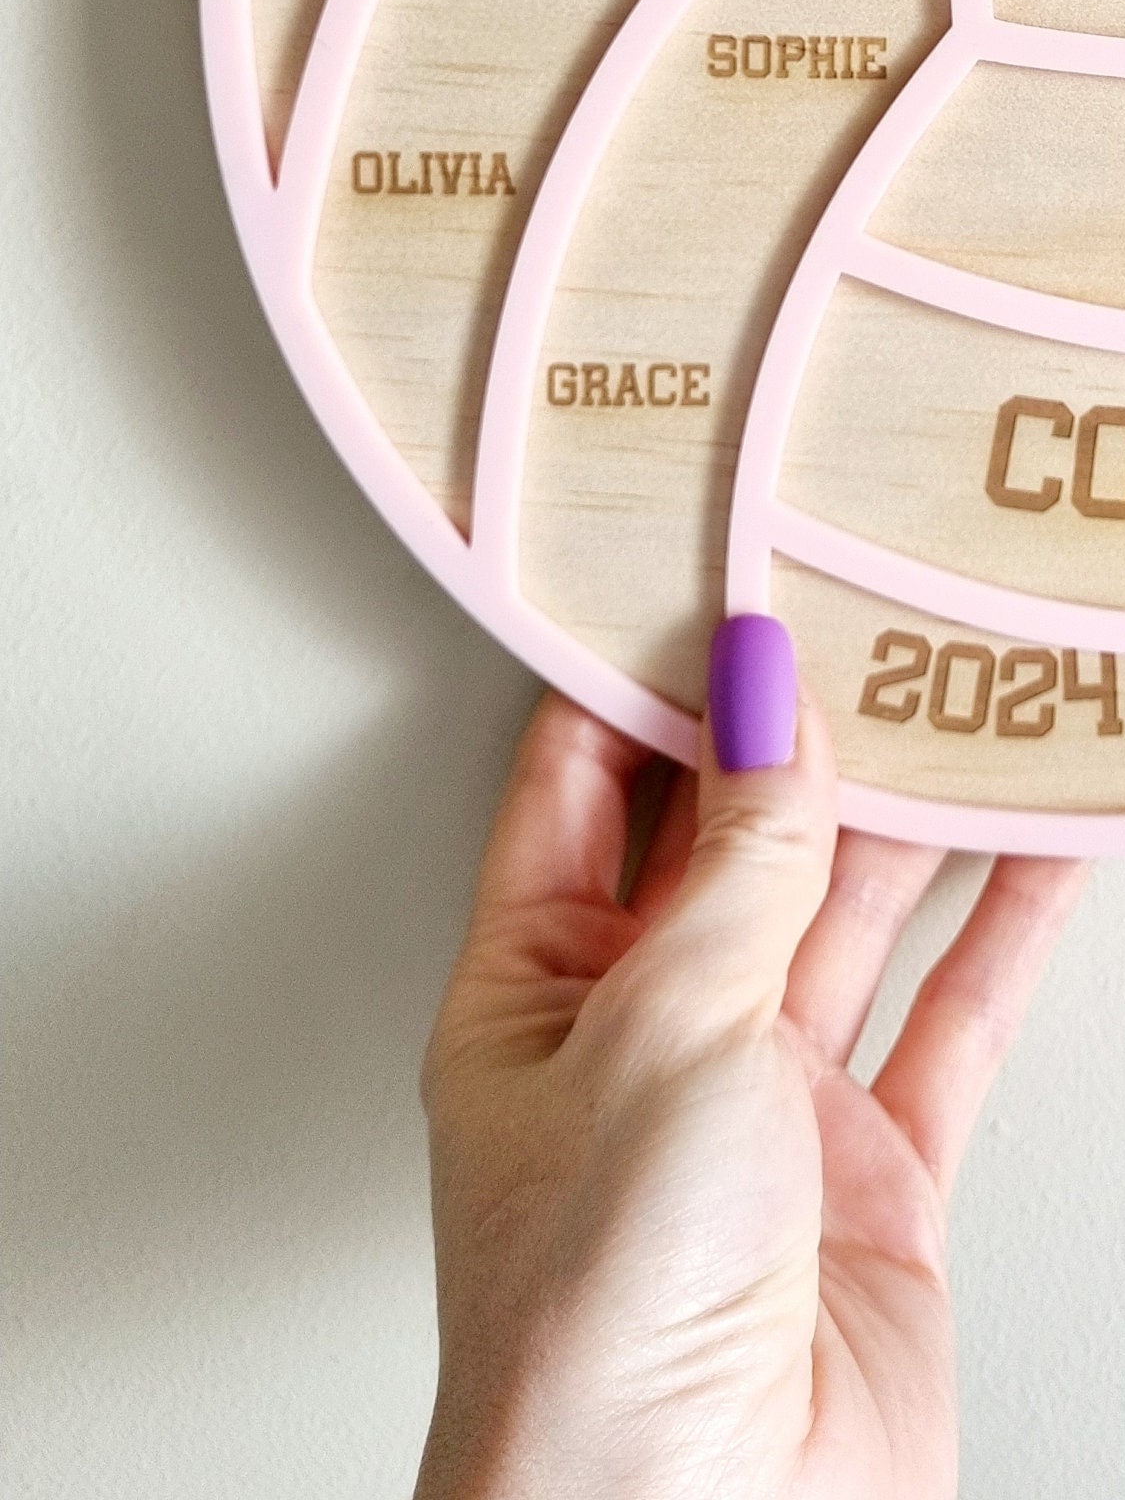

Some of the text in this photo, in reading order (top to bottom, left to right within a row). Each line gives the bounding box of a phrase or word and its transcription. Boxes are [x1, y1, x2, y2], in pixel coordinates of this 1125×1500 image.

[706, 33, 889, 81] SOPHIE
[351, 150, 518, 197] OLIVIA
[546, 362, 711, 408] GRACE
[856, 628, 1125, 741] 2024
